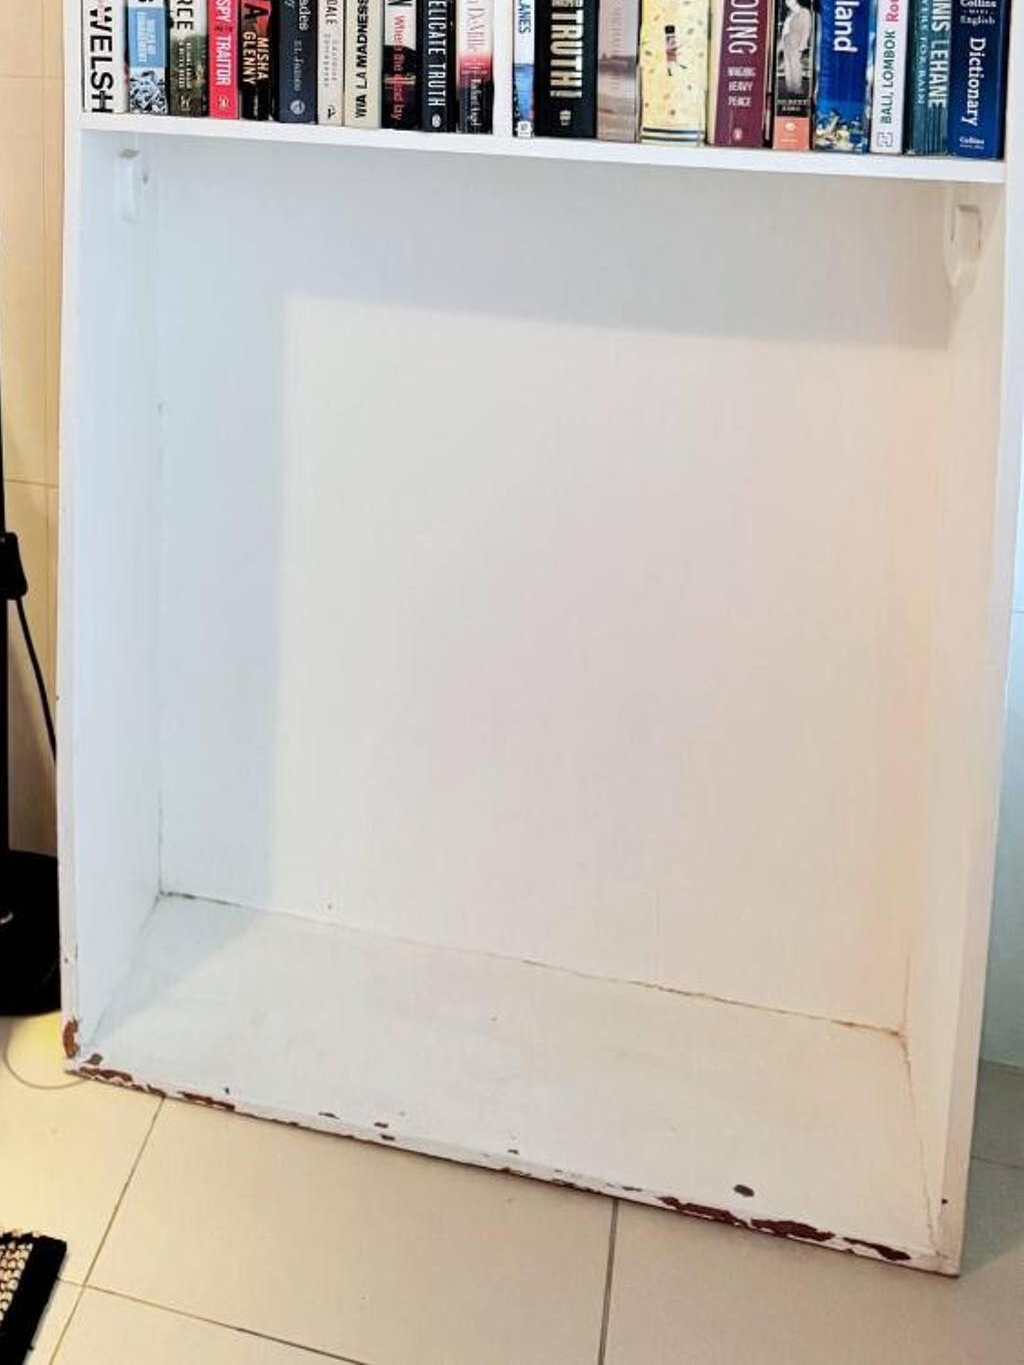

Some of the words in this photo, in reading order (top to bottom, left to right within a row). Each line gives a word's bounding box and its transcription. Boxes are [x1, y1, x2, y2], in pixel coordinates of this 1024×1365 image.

[89, 6, 113, 113] WELSH
[217, 35, 230, 85] TRAITOR
[243, 32, 256, 84] GLENNY
[257, 37, 269, 80] MISHA
[357, 72, 366, 89] LA
[883, 31, 895, 88] LOMBOK
[928, 39, 949, 108] LEHANE
[961, 36, 986, 126] Dictionary
[429, 64, 446, 106] TRUTH
